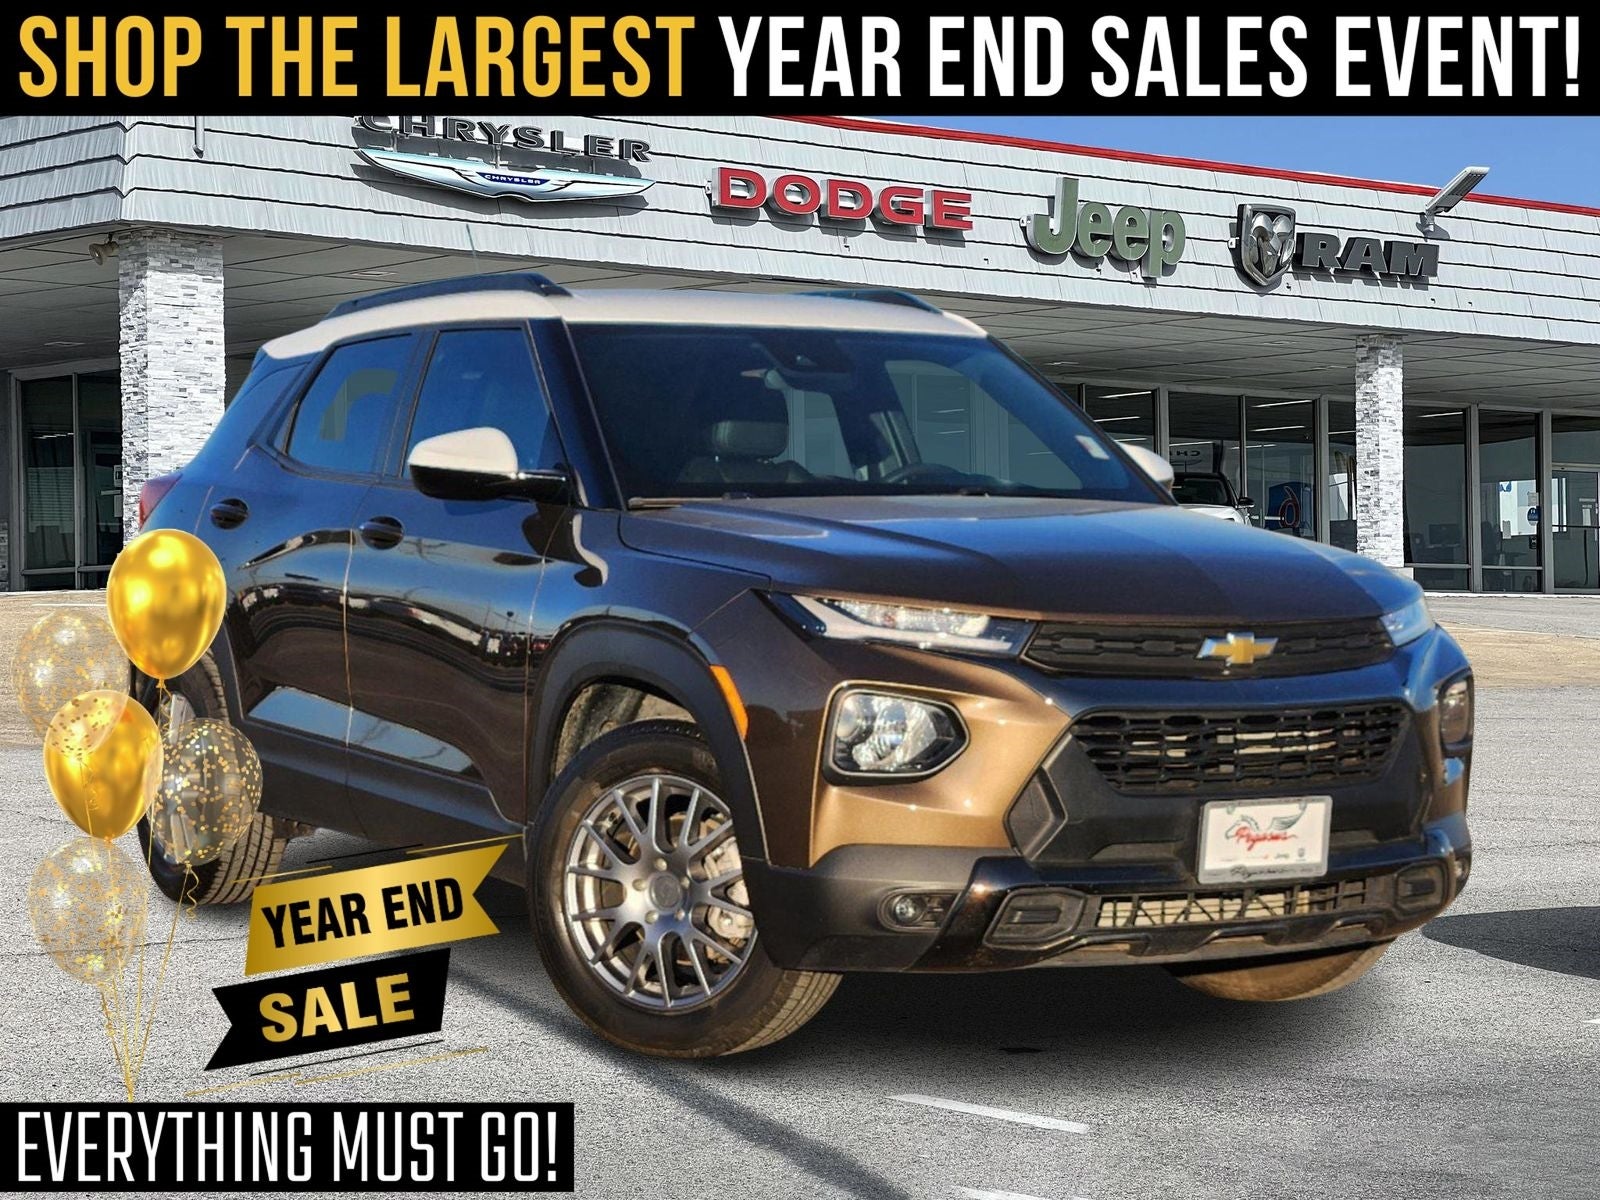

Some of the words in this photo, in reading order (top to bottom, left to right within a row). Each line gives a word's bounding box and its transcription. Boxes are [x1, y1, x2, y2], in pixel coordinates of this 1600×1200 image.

[358, 116, 651, 162] CHRYSLER
[484, 174, 541, 185] CHRYSLER
[712, 167, 973, 231] DODGE
[1027, 177, 1187, 278] Jeep
[1299, 232, 1440, 278] RAM
